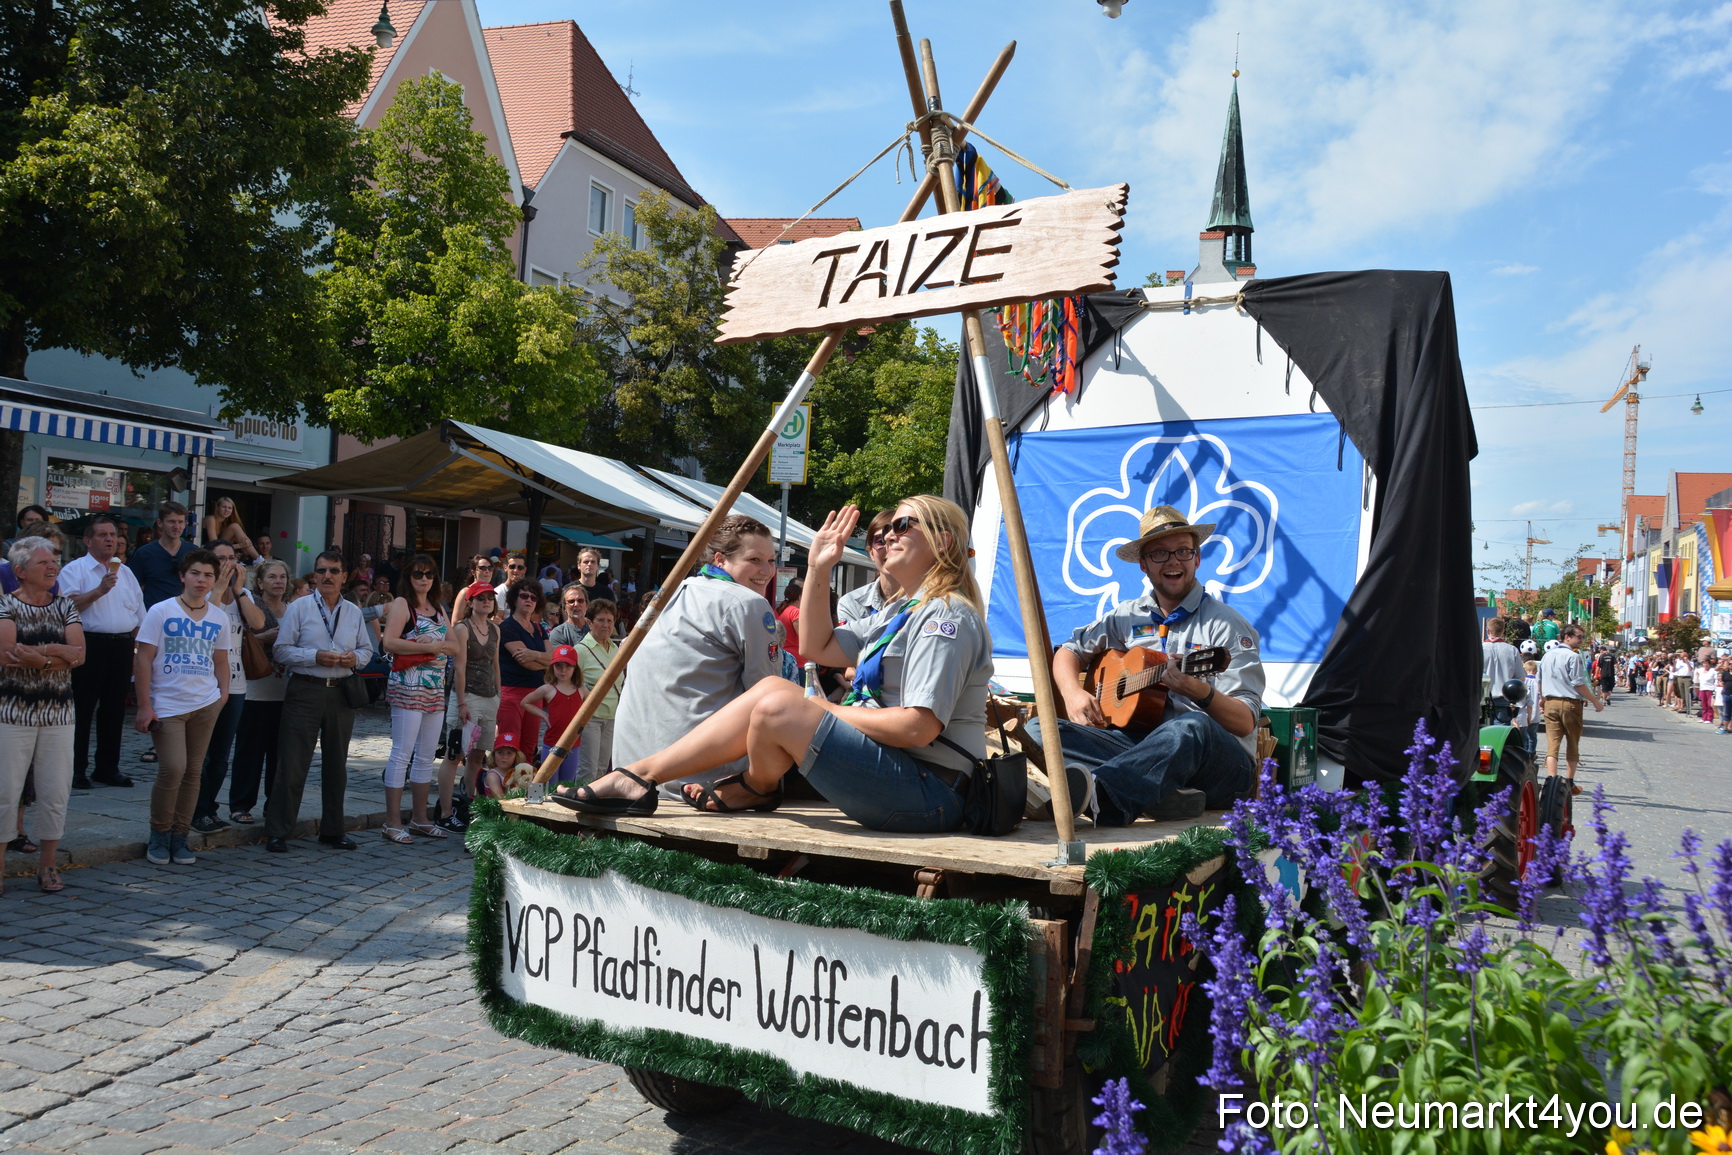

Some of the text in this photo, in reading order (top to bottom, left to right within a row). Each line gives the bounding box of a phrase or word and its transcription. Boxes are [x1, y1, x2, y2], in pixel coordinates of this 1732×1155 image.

[812, 207, 1022, 309] TAIZÉ
[222, 417, 297, 441] appuccino
[505, 900, 563, 982] VCP
[572, 913, 742, 1022] Pfadfinder
[752, 943, 992, 1075] Woffenbach
